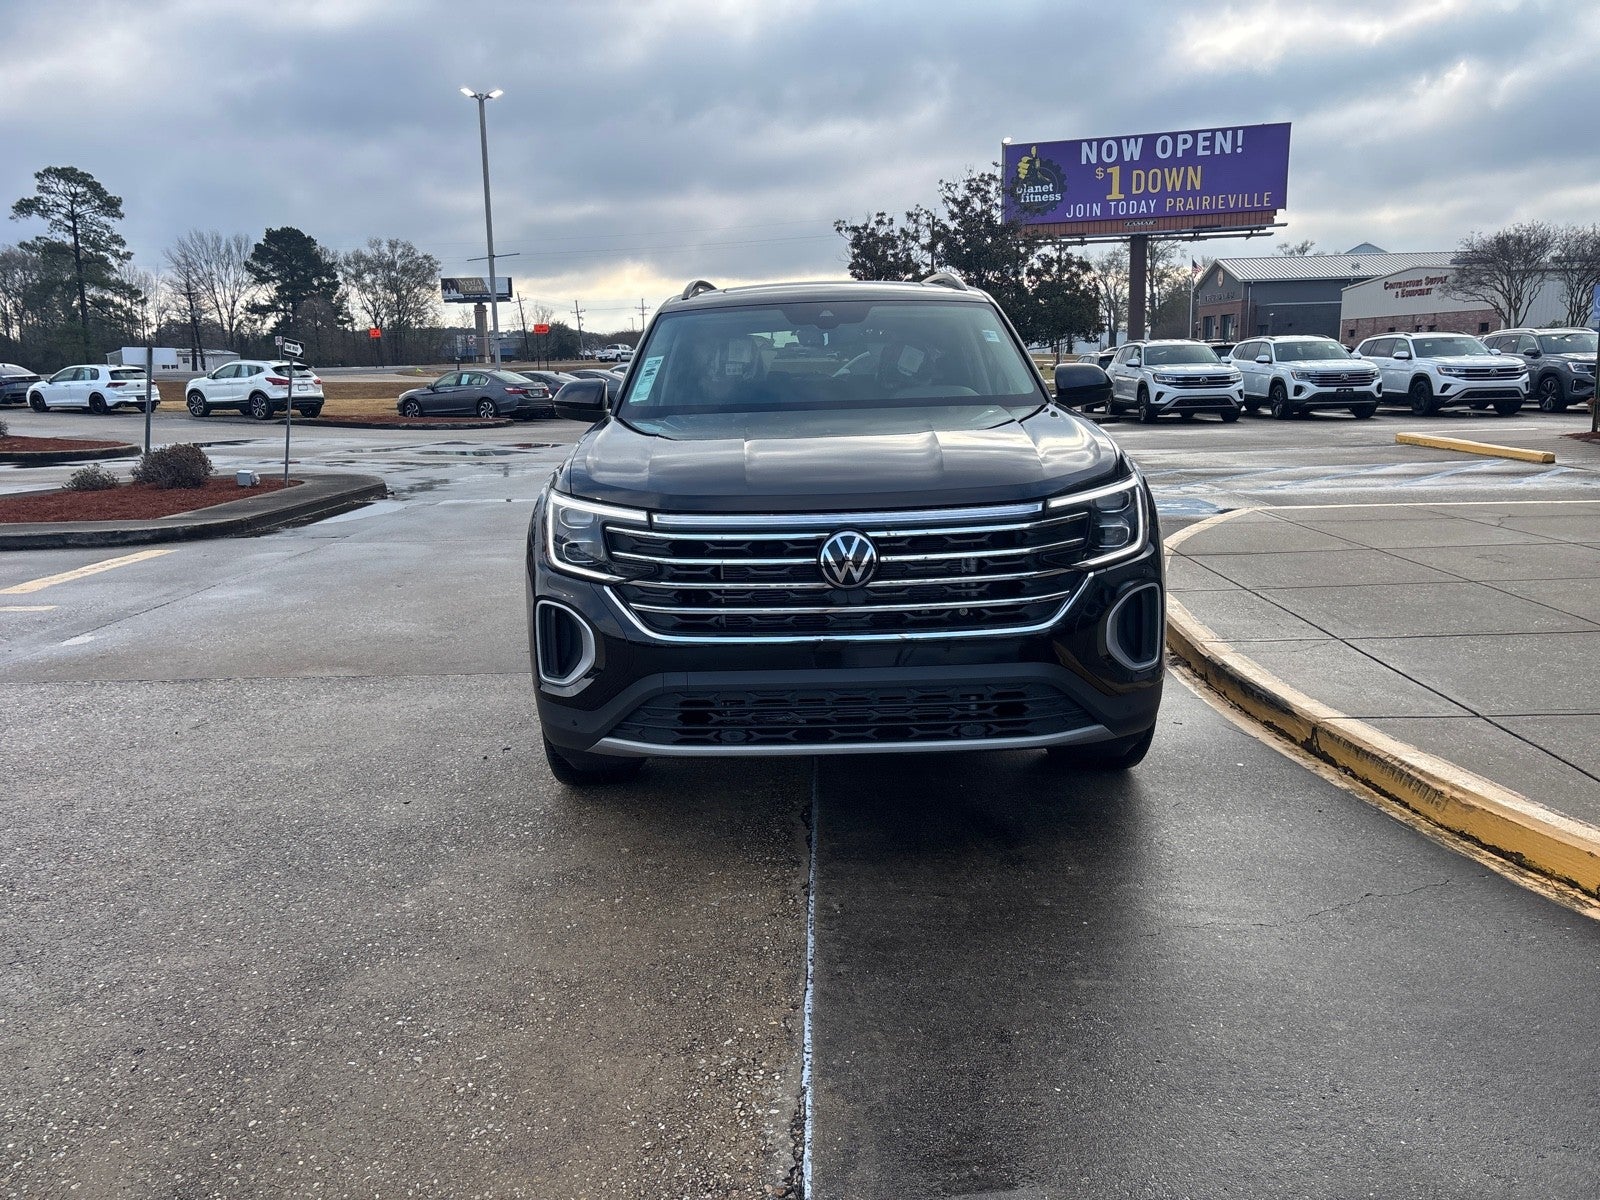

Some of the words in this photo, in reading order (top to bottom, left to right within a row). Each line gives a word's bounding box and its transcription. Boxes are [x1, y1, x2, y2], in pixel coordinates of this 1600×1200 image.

[1081, 137, 1144, 165] NOW
[1155, 129, 1244, 159] OPEN!
[1020, 193, 1062, 203] fitness
[1095, 165, 1125, 200] $1
[1132, 165, 1202, 195] DOWN
[1066, 203, 1101, 219] JOIN
[1109, 199, 1157, 216] TODAY
[1166, 191, 1272, 212] PRAIRIEVILLE
